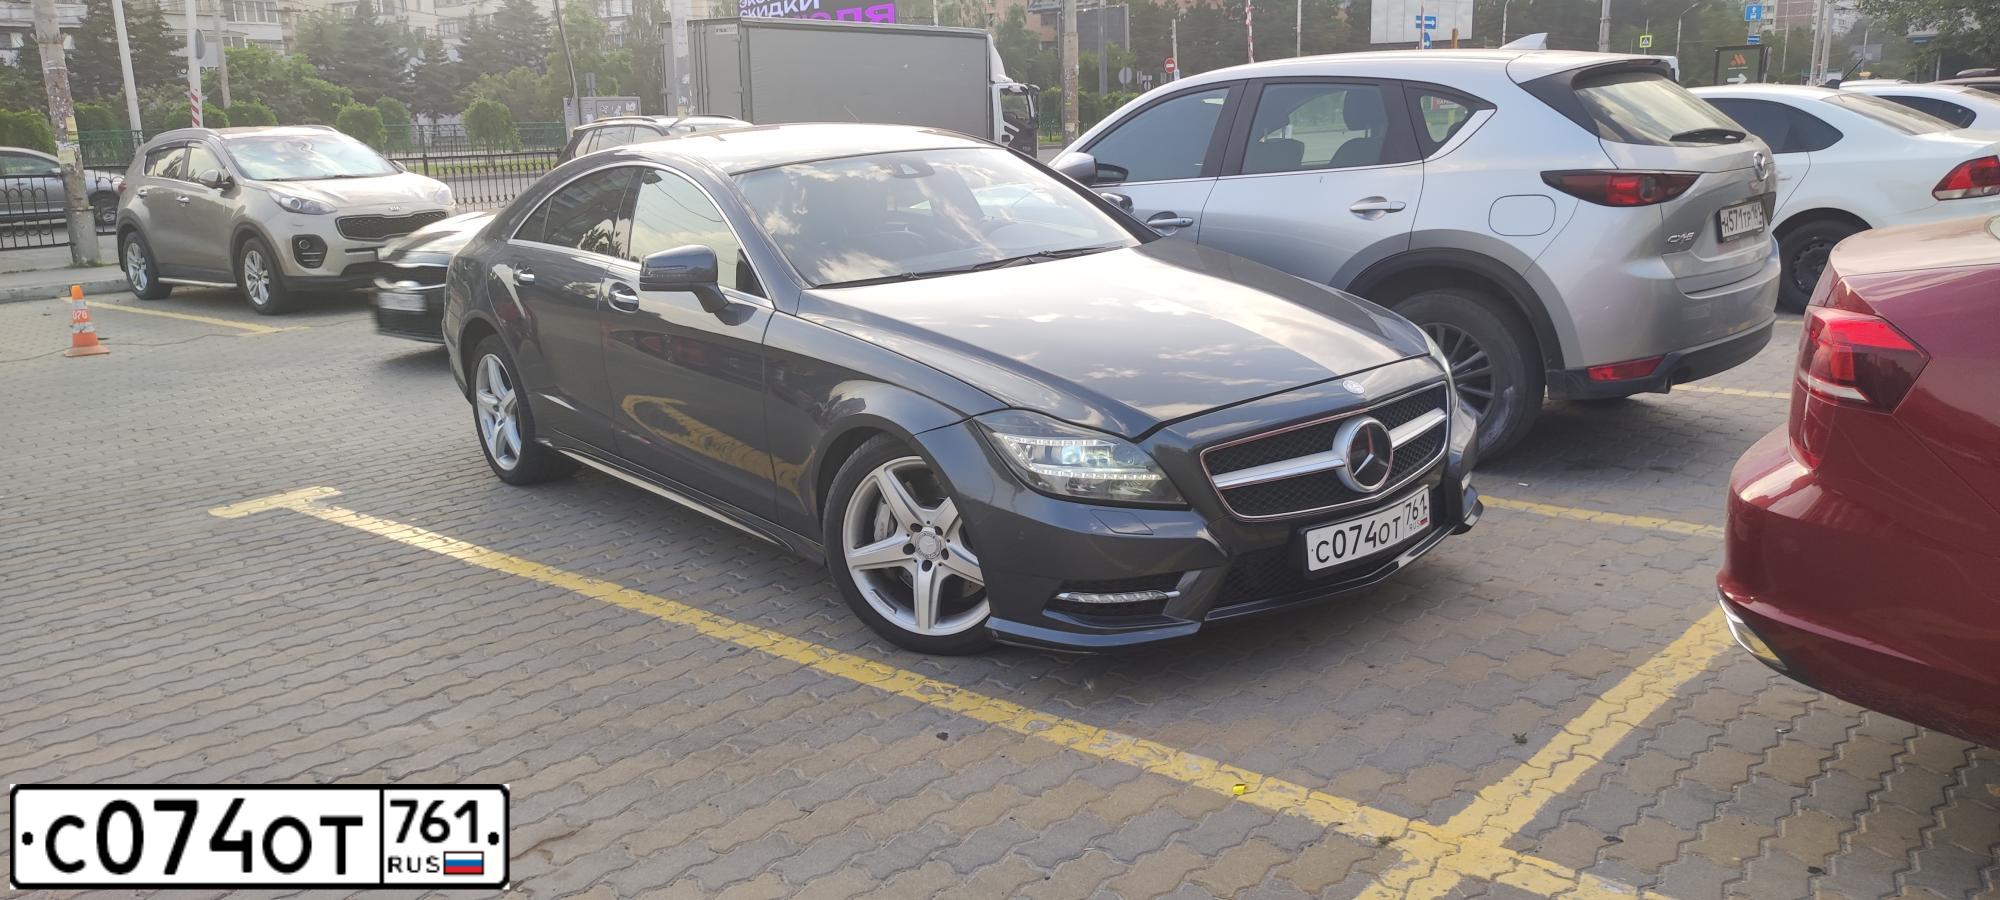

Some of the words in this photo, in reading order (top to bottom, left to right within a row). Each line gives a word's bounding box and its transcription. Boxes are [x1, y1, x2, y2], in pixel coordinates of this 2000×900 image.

[740, 0, 820, 18] СКИДКИ
[1315, 516, 1401, 563] С074ОТ
[1405, 493, 1426, 525] 761
